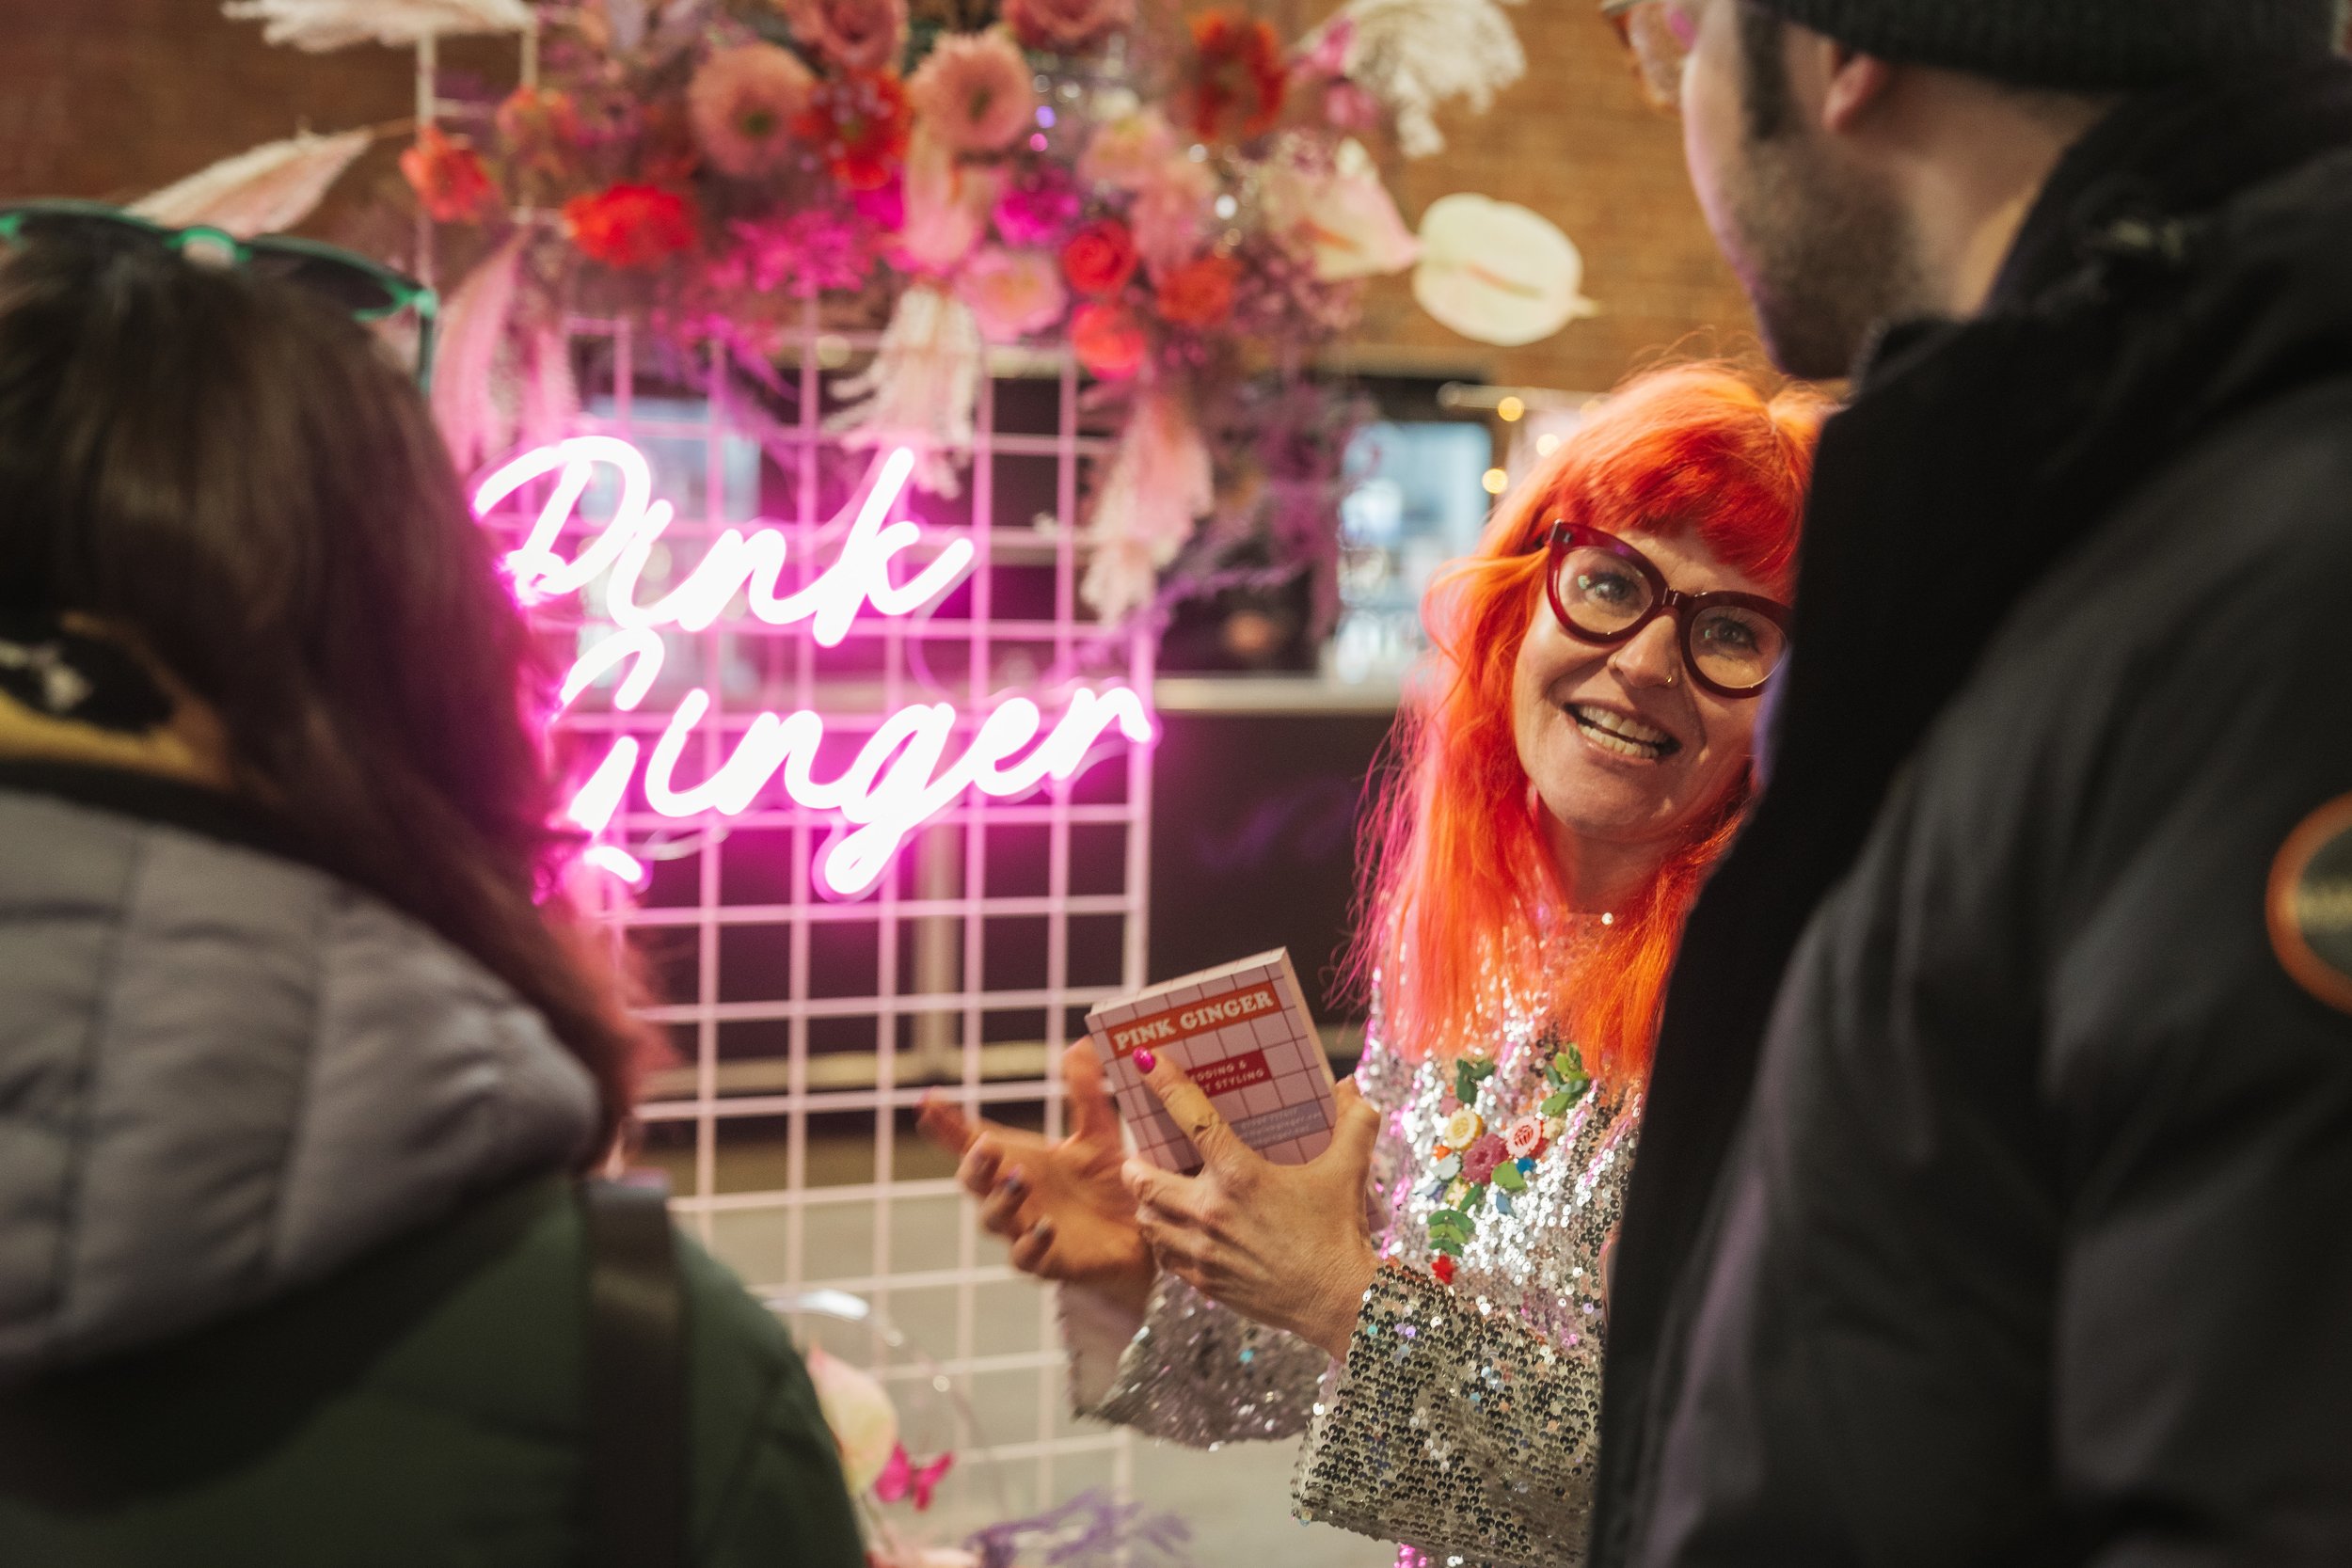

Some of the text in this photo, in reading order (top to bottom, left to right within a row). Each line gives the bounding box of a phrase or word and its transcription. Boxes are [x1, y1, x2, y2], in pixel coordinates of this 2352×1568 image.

[473, 436, 976, 648] Pink
[1113, 990, 1275, 1052] PINK GINGER
[1215, 1067, 1264, 1091] STYLING
